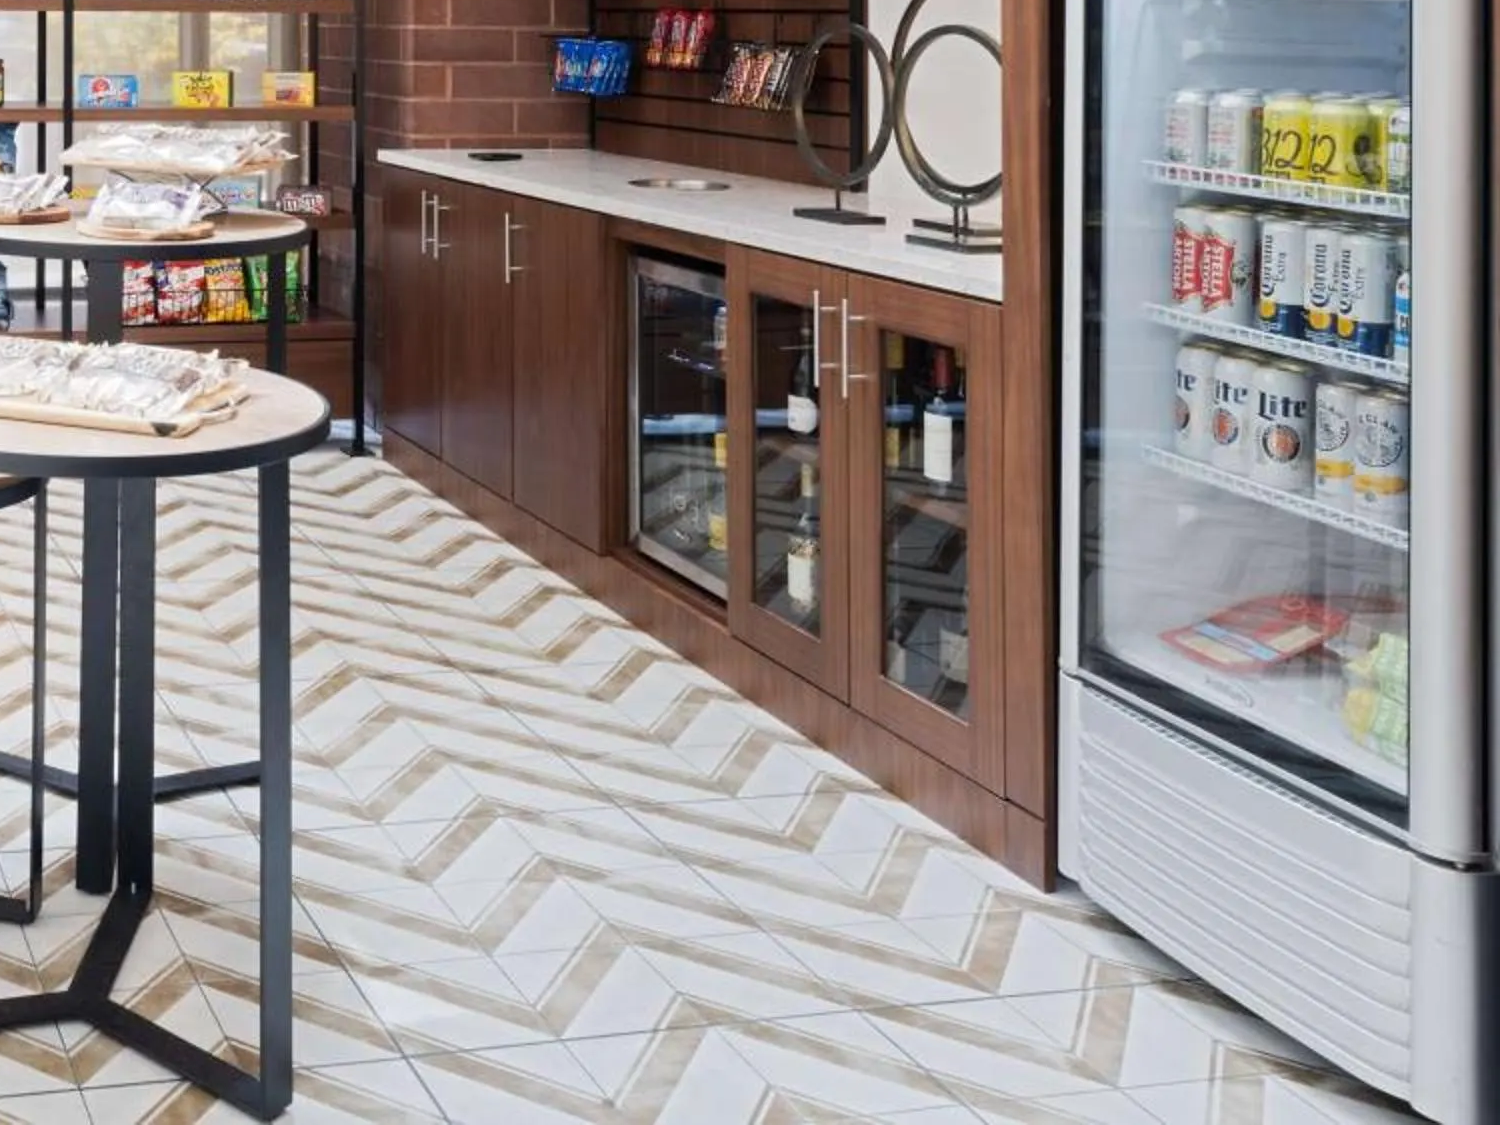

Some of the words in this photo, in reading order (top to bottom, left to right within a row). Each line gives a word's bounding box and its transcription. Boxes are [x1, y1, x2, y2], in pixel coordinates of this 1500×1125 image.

[1307, 133, 1340, 176] 12
[1211, 245, 1225, 297] STELLA
[1310, 244, 1330, 307] Corona
[1214, 378, 1248, 405] ite
[1257, 390, 1307, 421] Lite
